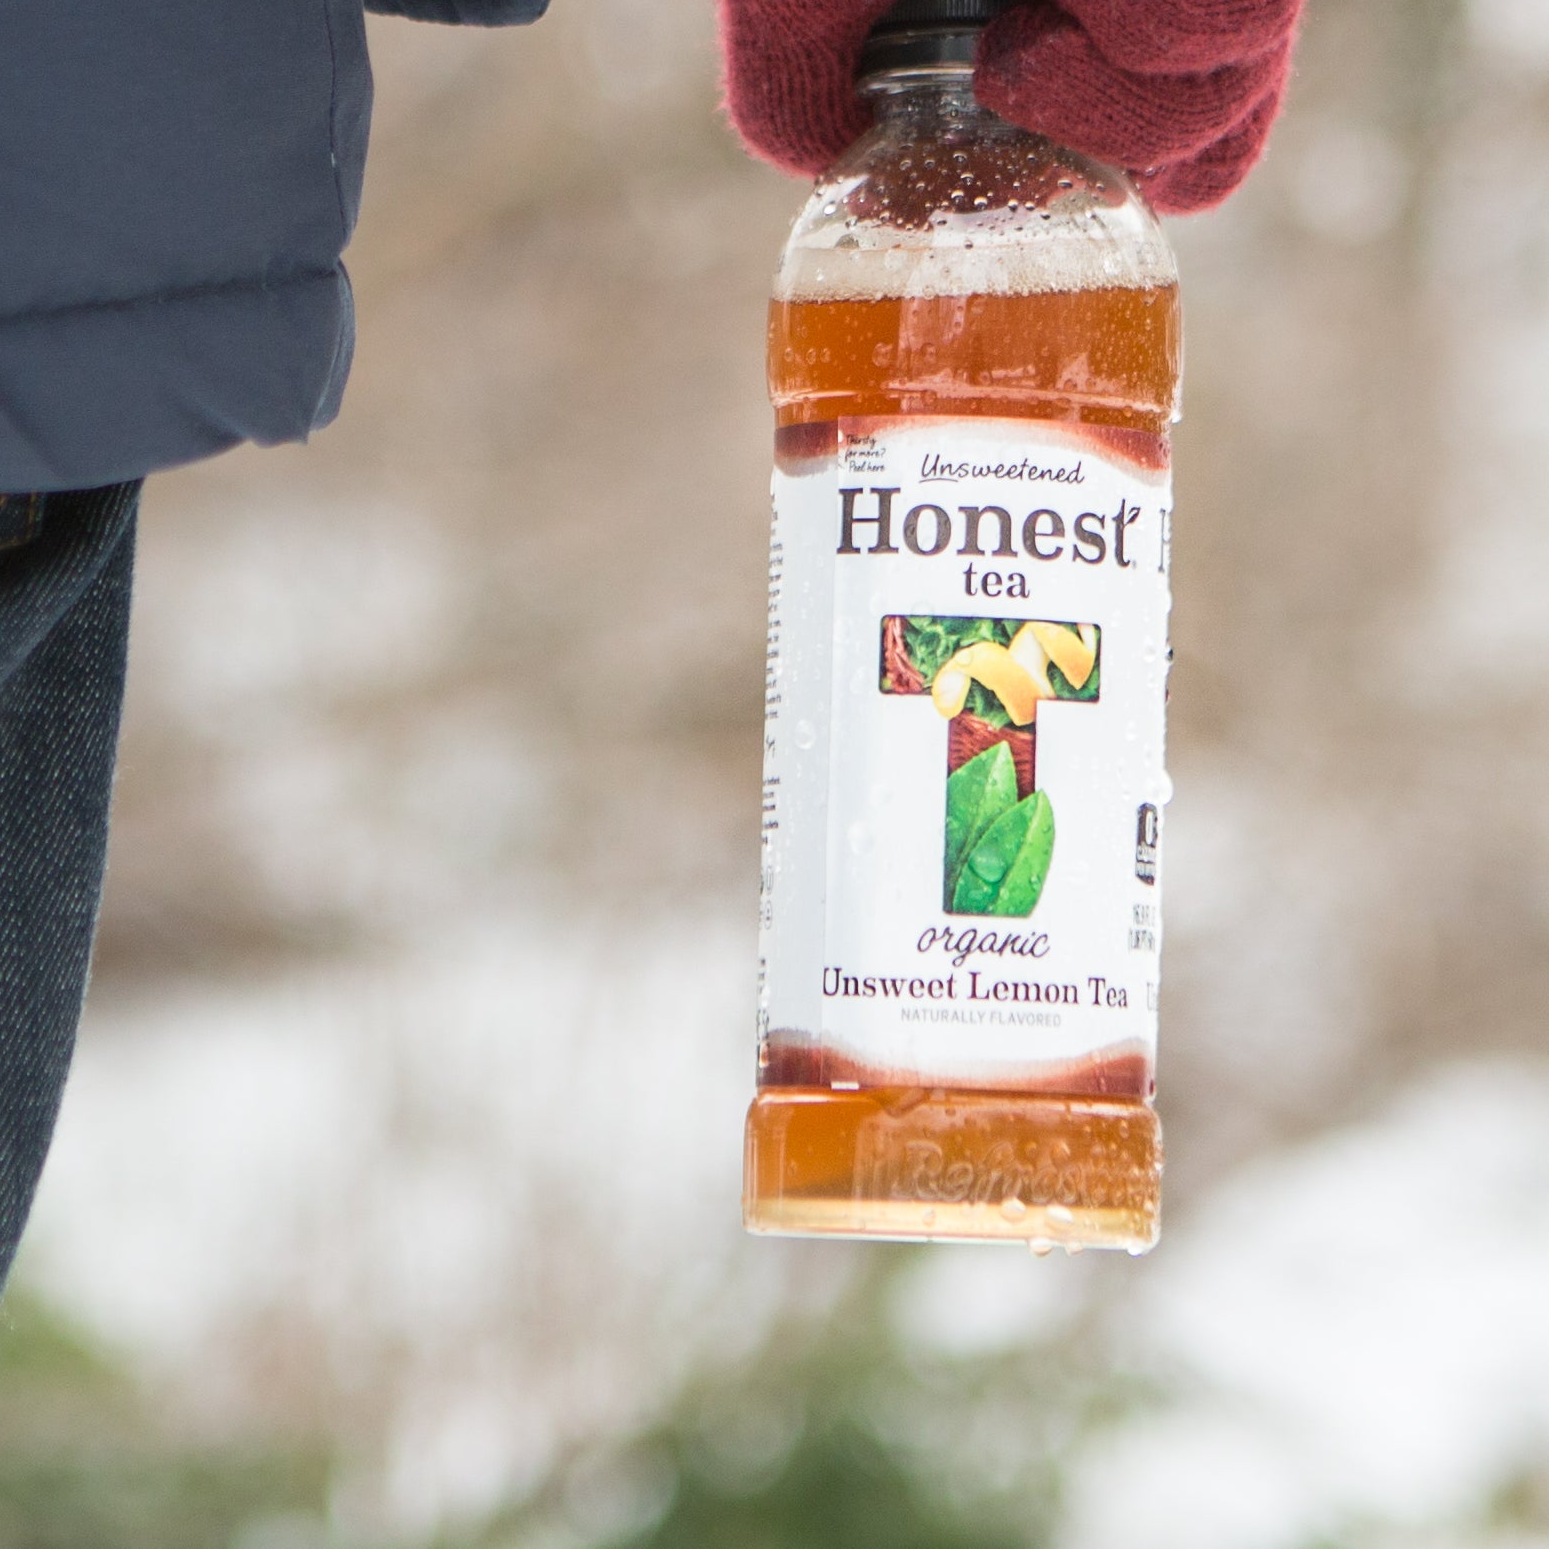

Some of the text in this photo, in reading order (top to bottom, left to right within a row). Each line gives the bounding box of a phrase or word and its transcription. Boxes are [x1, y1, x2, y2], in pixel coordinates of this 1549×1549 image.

[849, 461, 885, 471] Peel here
[920, 454, 1085, 484] Unsweetened
[836, 487, 1141, 568] Honest
[962, 562, 1031, 599] tea
[917, 926, 1050, 967] organic
[823, 967, 958, 999] Unsweet
[966, 971, 1080, 1005] Lemon
[1087, 977, 1129, 1008] Tea
[900, 1007, 1062, 1028] NATURALLY FLAVORED
